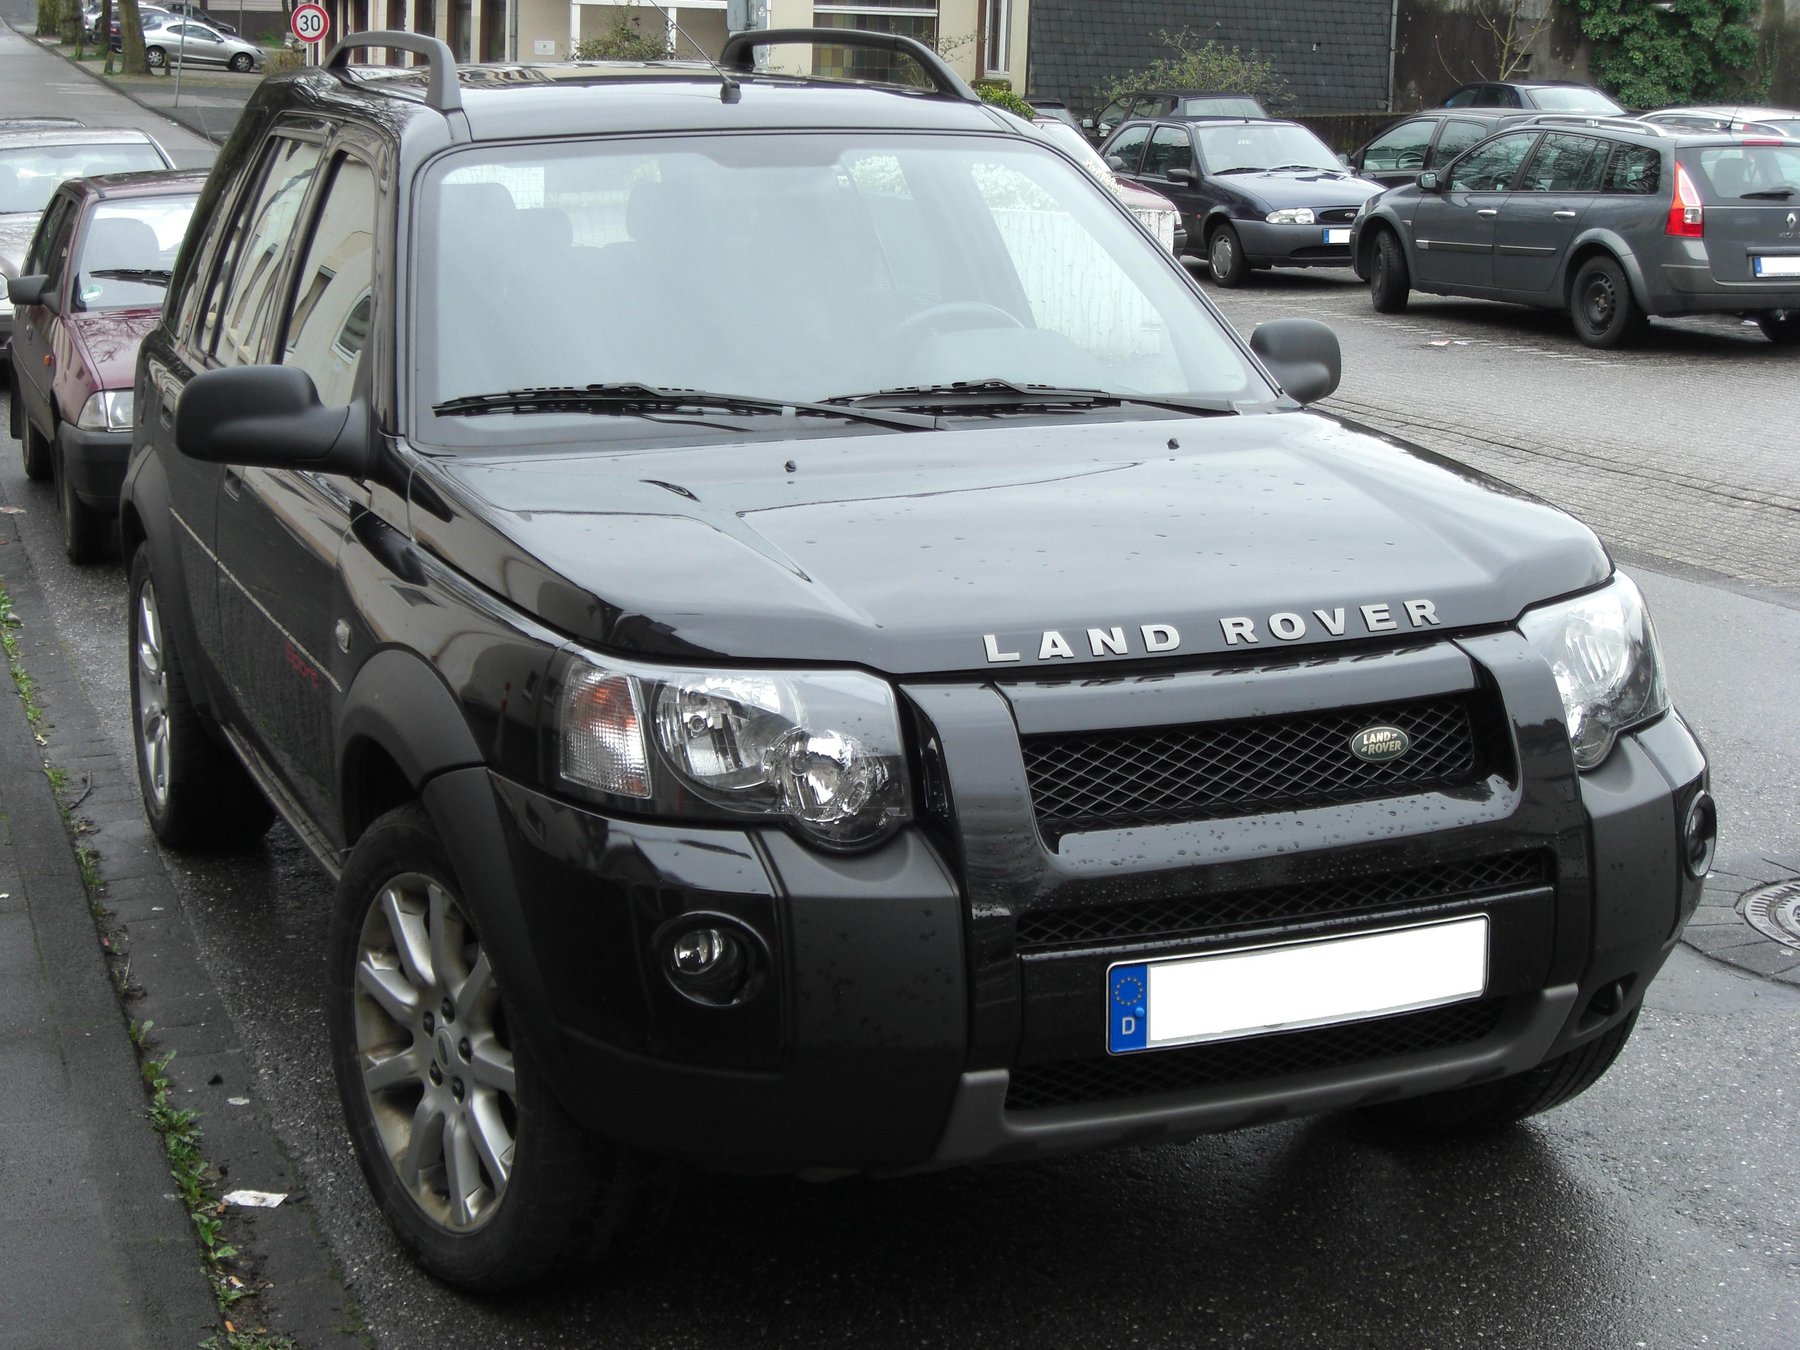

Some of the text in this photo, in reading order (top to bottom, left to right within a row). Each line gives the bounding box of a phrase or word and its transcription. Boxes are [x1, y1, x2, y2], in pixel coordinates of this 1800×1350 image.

[300, 14, 321, 32] 30
[983, 598, 1441, 662] LAND ROVER
[1363, 731, 1391, 745] LAND
[1367, 740, 1402, 755] ROVER
[1122, 1016, 1136, 1036] D
